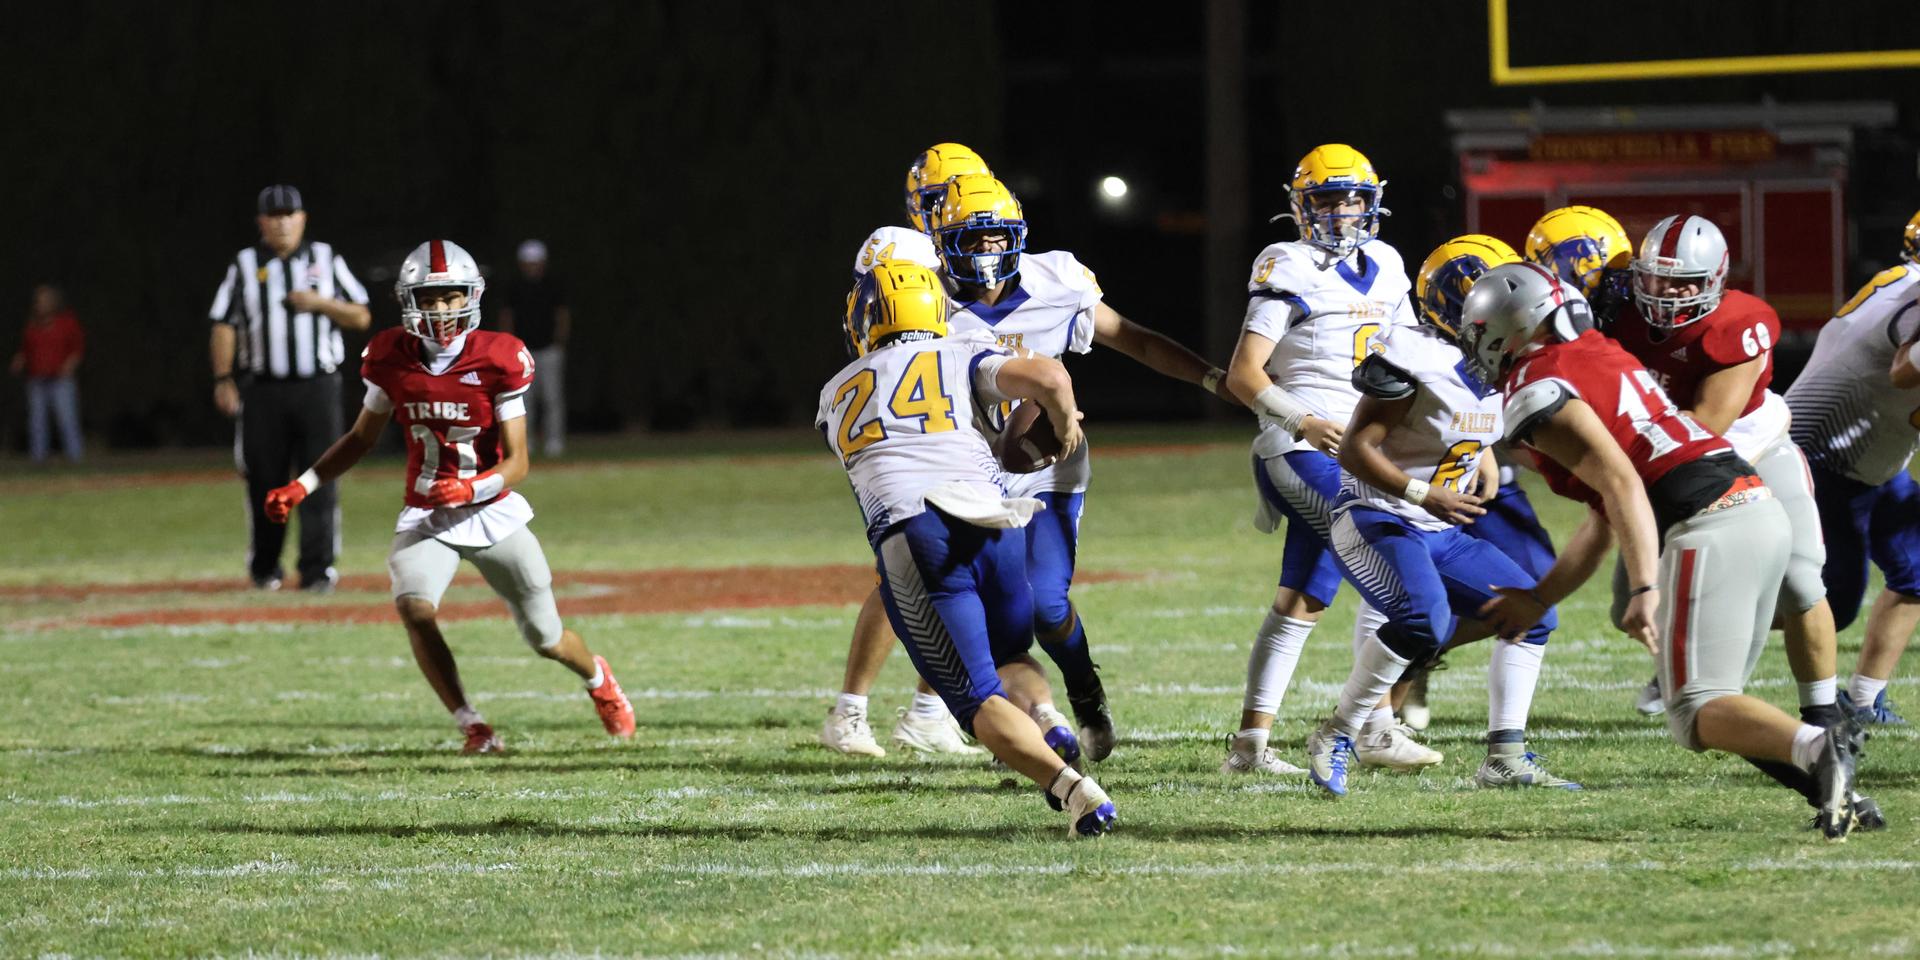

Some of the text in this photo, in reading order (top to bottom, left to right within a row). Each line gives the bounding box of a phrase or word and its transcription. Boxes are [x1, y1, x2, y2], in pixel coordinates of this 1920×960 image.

[861, 238, 897, 266] 54
[1742, 321, 1771, 357] 60
[404, 401, 471, 421] TRIBE
[831, 350, 959, 467] 24
[1429, 439, 1482, 493] 6
[1488, 758, 1516, 779] NIKE
